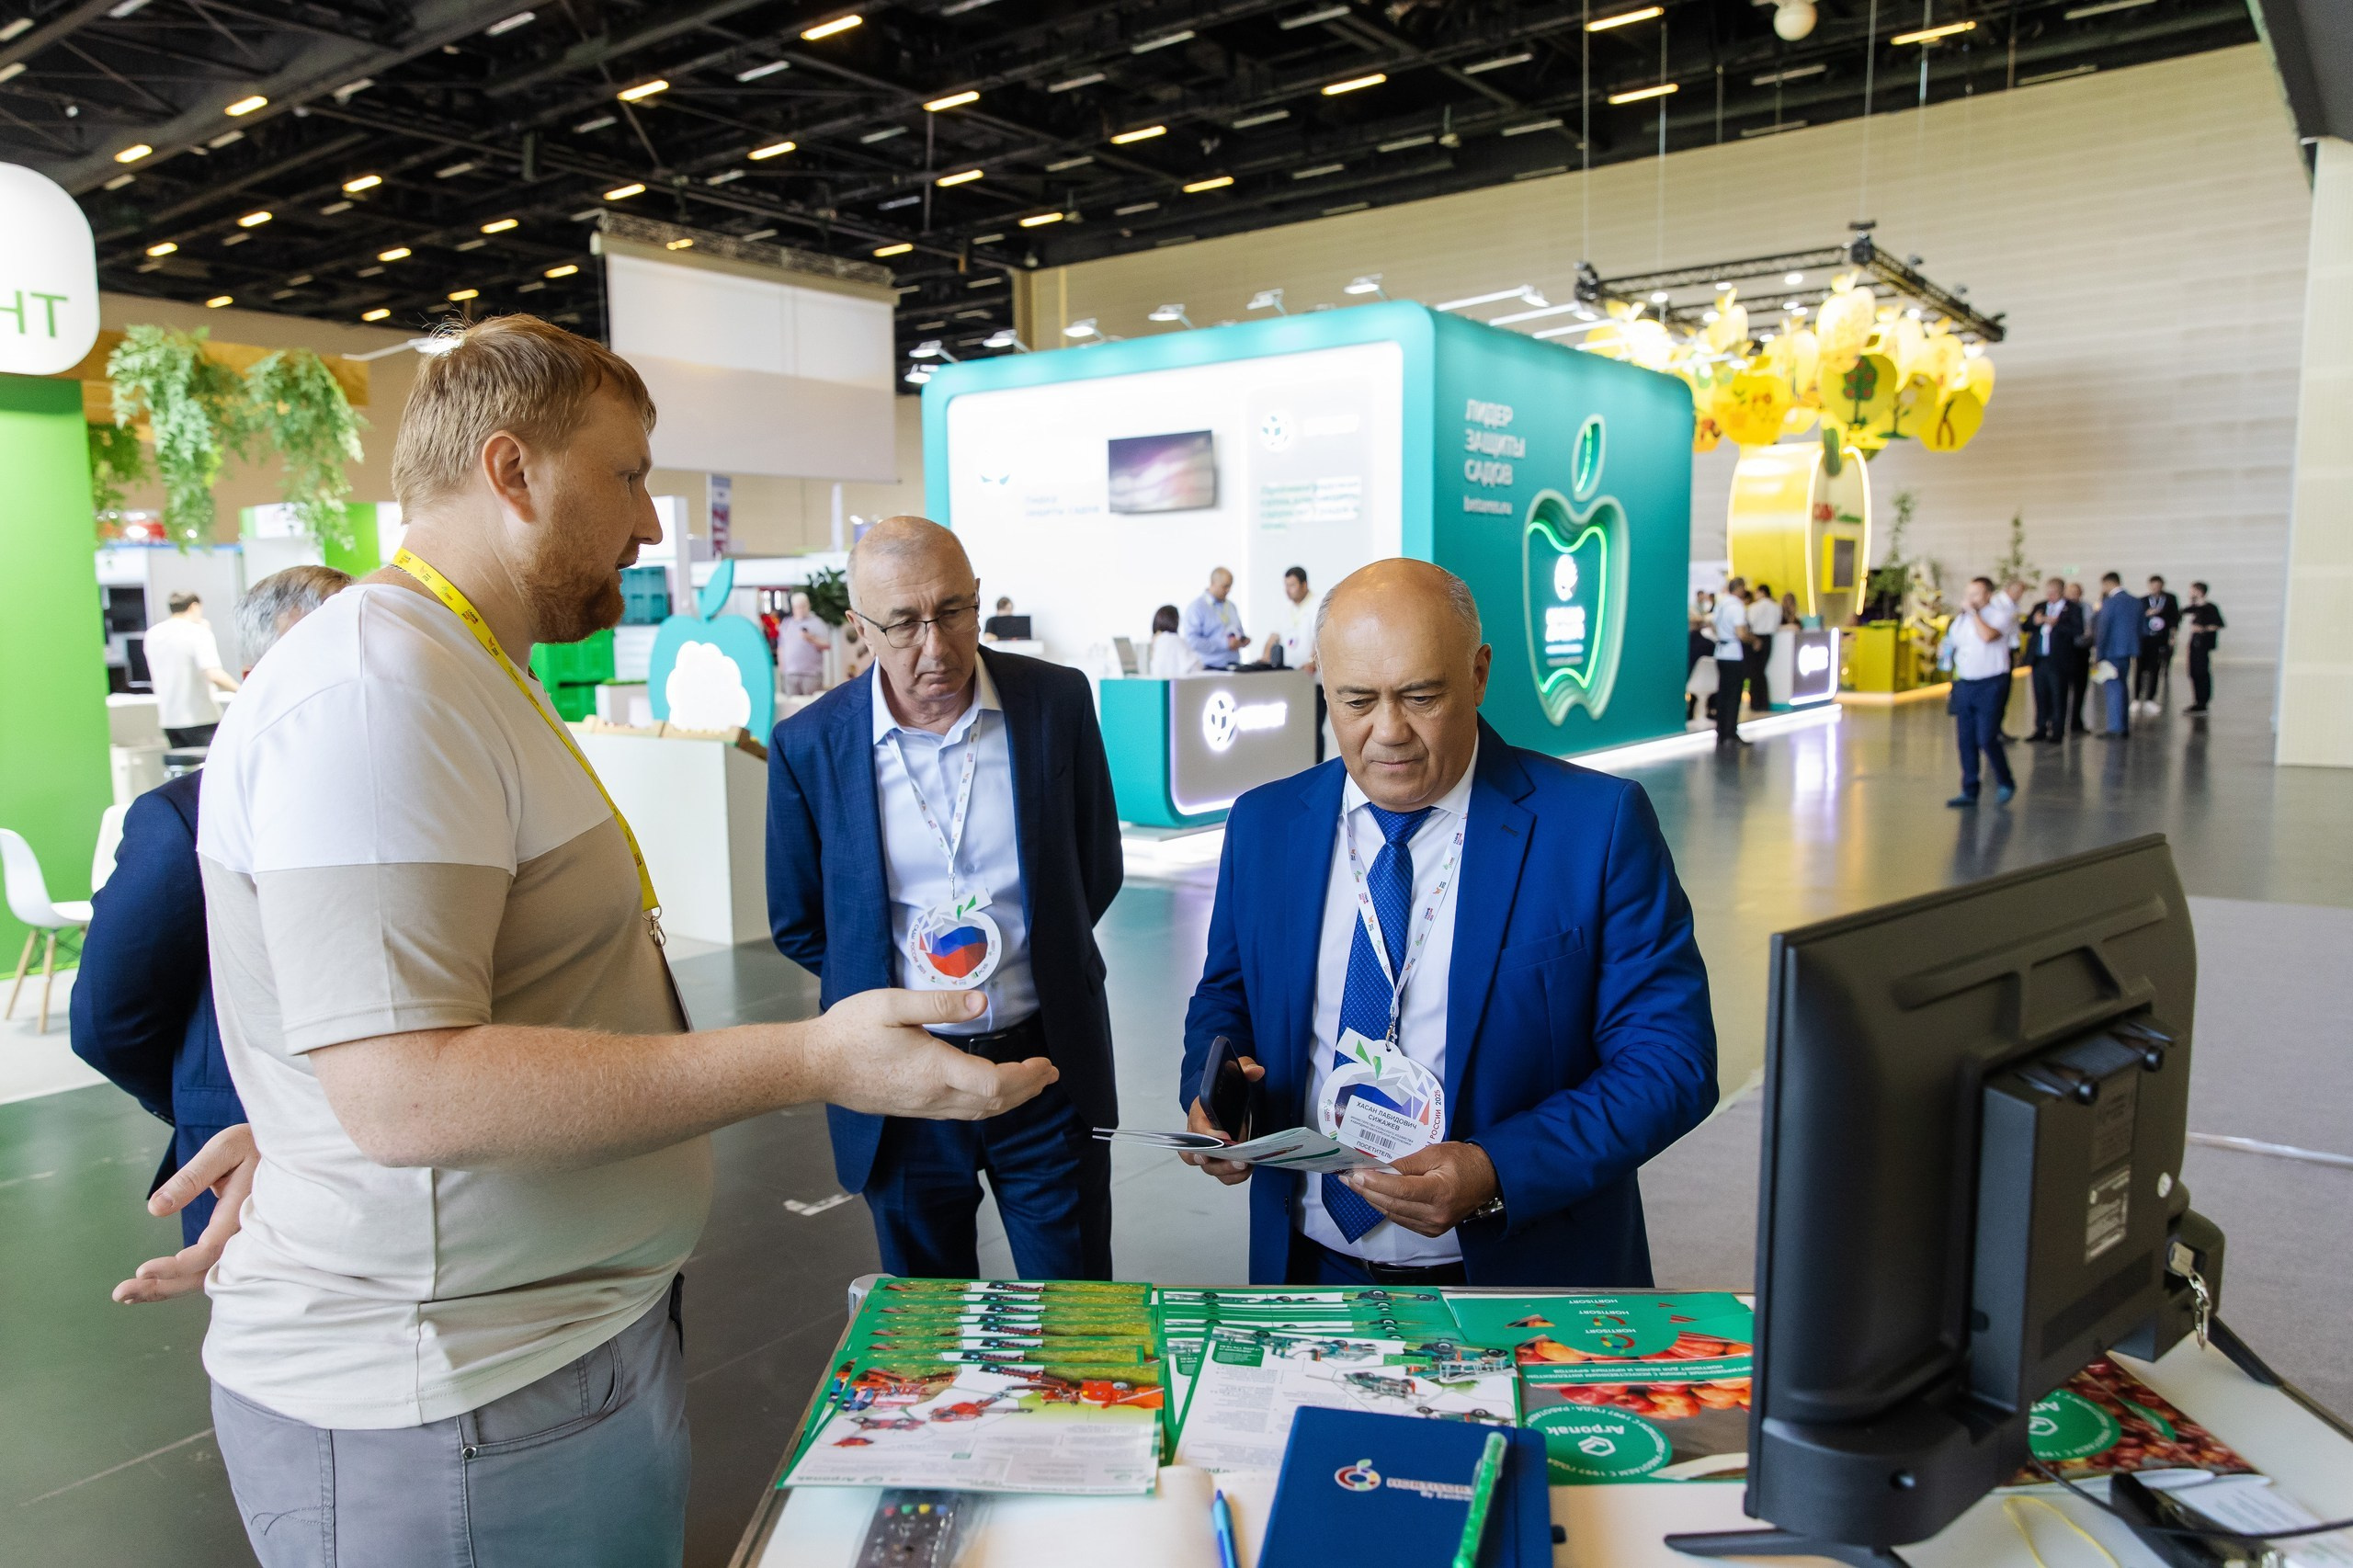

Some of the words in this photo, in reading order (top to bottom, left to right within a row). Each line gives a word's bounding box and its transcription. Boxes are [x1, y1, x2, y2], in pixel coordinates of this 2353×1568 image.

[1465, 398, 1513, 429] ЛИДЕР
[1464, 427, 1526, 459] ЗАЩИТЫ
[1464, 459, 1513, 487] САДОВ
[1356, 1101, 1378, 1114] ХАСАН
[1434, 1089, 1442, 1106] 2025
[1368, 1114, 1401, 1131] СИЖАЖЕВ
[1429, 1109, 1441, 1140] РОССИИ
[1356, 1141, 1392, 1160] ПОСЕТИТЕЛЬ
